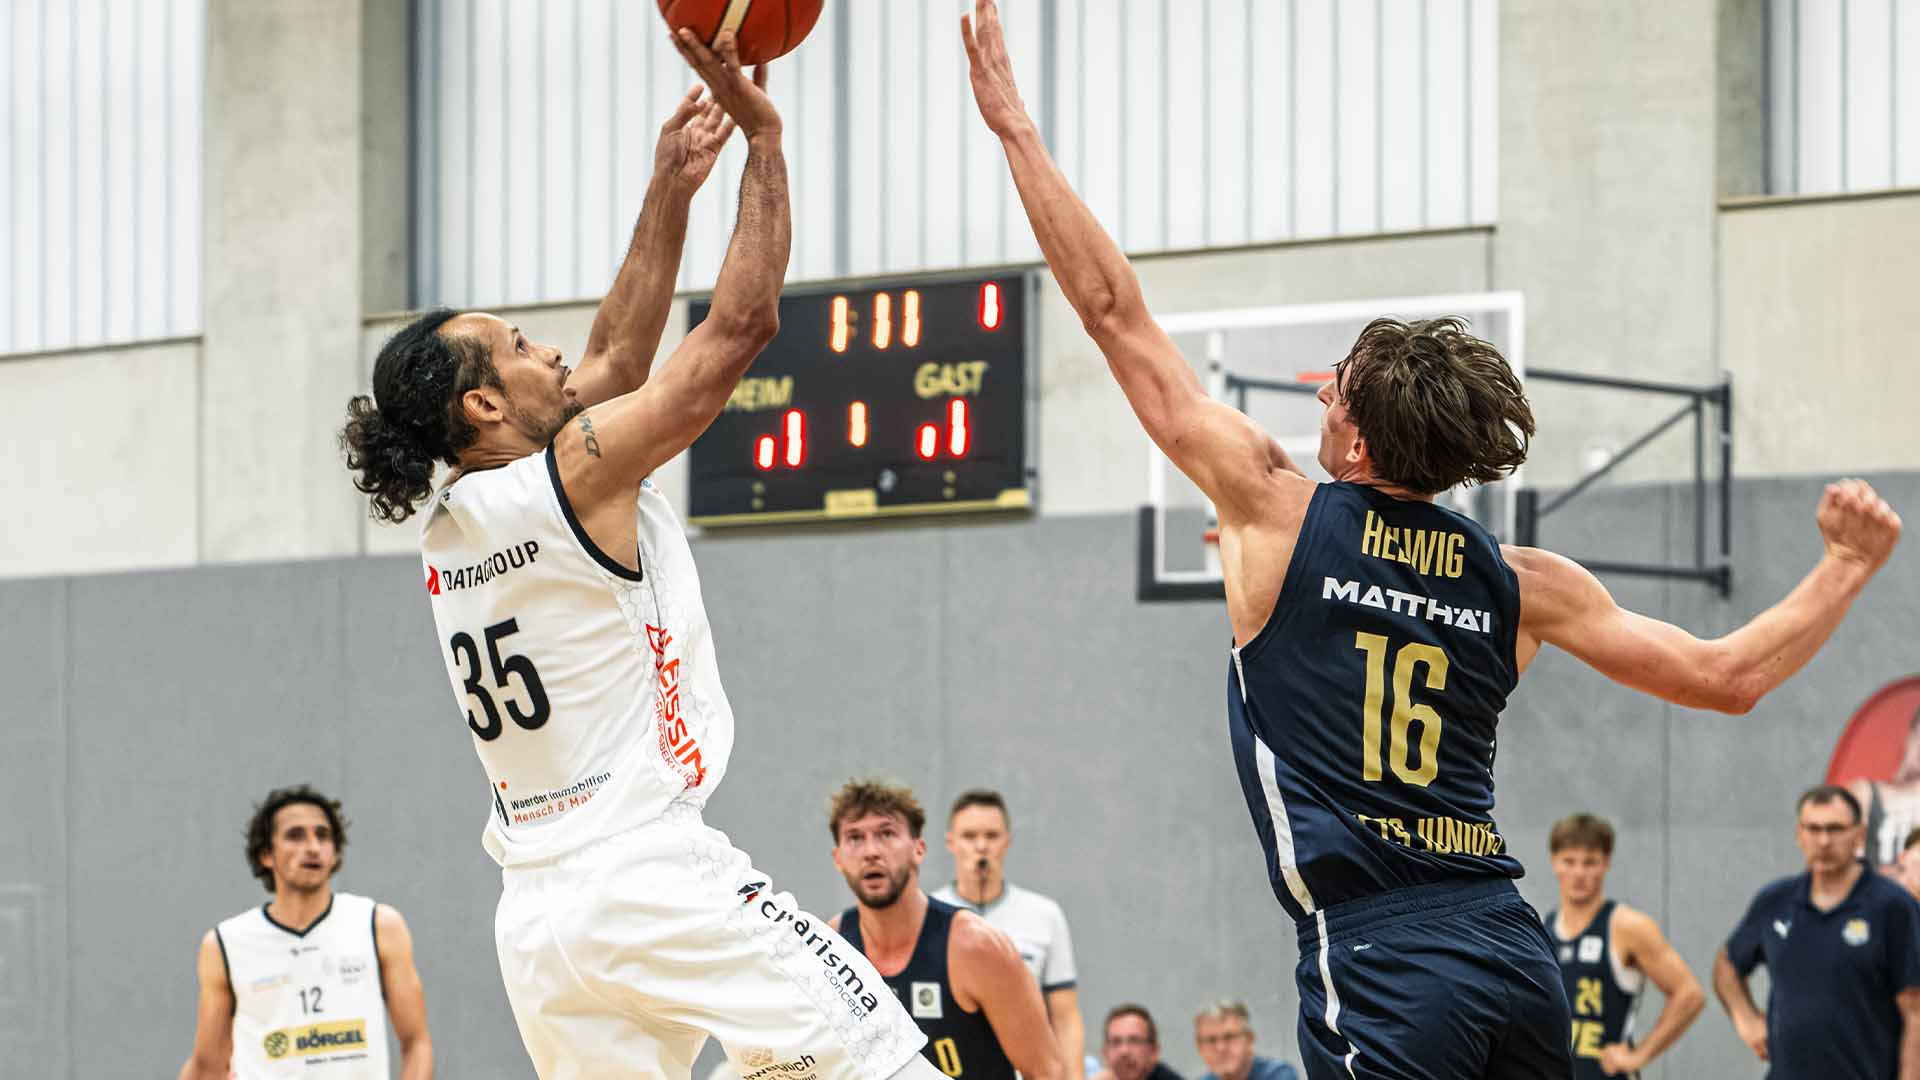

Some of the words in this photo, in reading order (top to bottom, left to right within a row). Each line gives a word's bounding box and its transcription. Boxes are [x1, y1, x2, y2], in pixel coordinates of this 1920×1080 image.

[914, 361, 989, 398] GAST
[443, 541, 539, 591] DATAGROUP
[1361, 510, 1466, 578] HELWIG
[1322, 577, 1491, 633] MATTHÄI
[450, 617, 552, 741] 35
[1354, 631, 1451, 788] 16
[514, 805, 554, 824] Mensch
[299, 985, 323, 1015] 12
[824, 969, 869, 1022] concept
[296, 1028, 365, 1050] BÖRGEL
